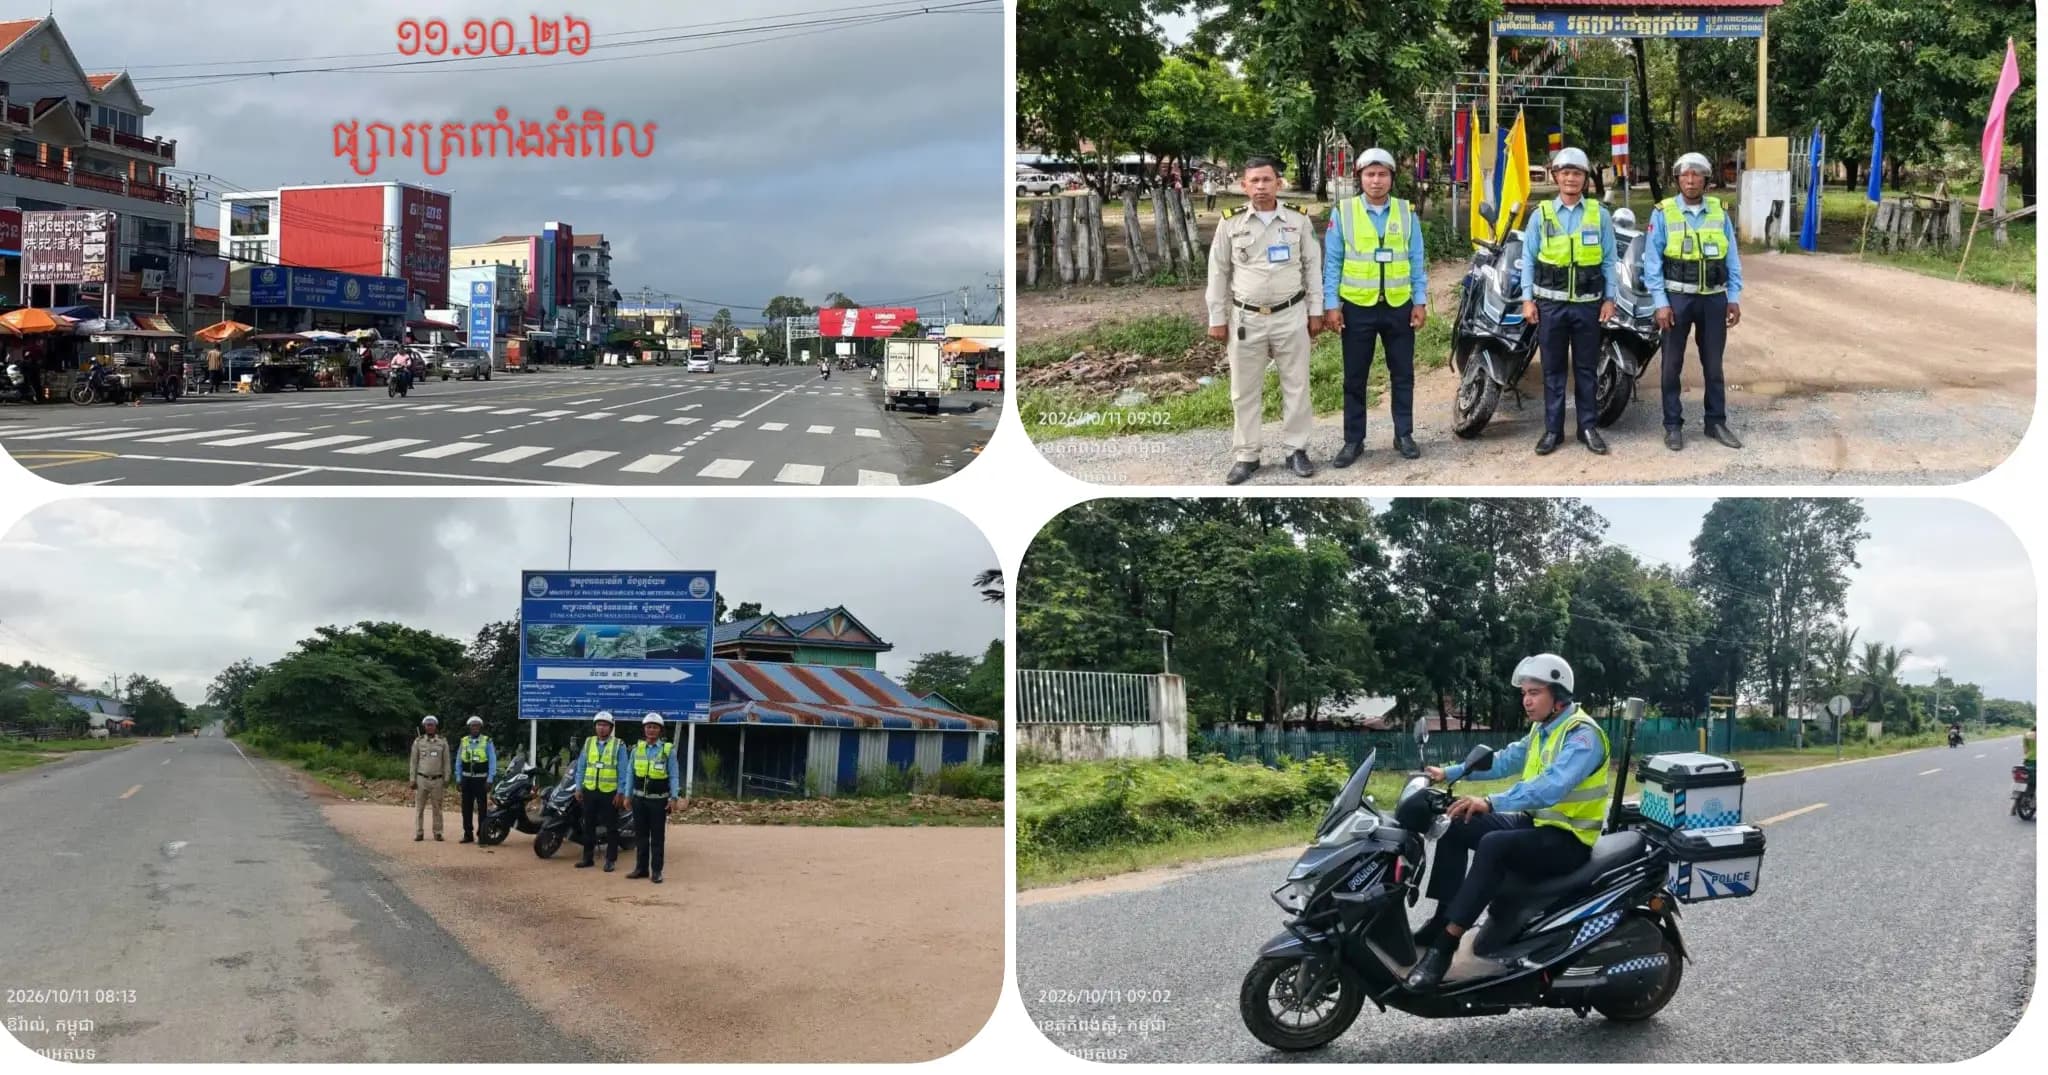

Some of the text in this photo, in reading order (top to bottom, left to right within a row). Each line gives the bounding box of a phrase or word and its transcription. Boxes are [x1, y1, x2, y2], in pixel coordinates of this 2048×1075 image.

[1643, 789, 1669, 807] POLICE
[1347, 861, 1379, 891] POLICE
[1711, 871, 1750, 884] POLICE
